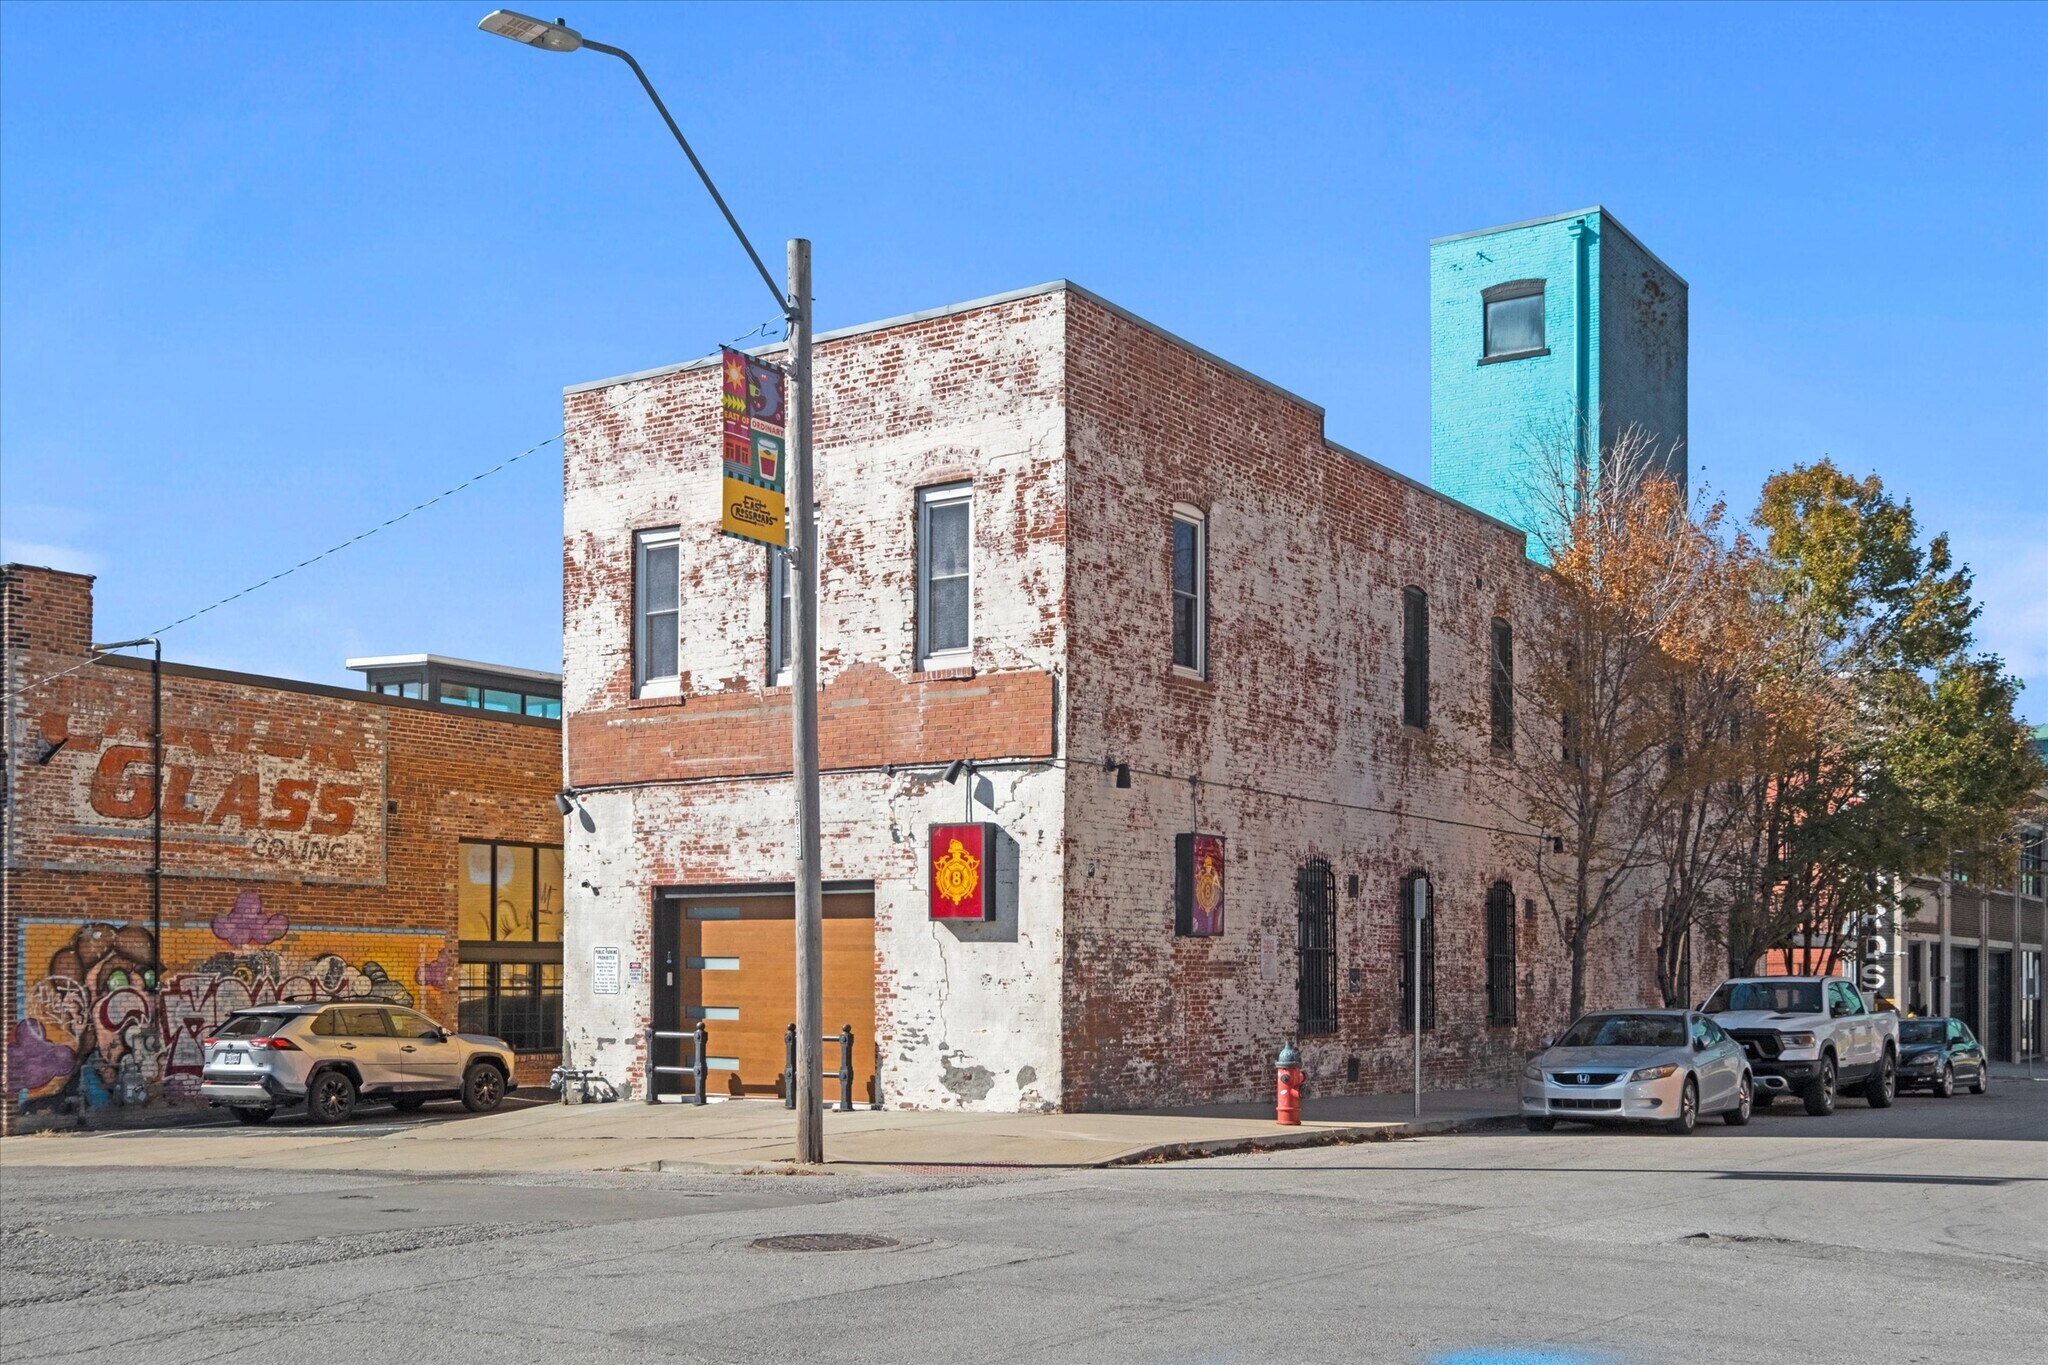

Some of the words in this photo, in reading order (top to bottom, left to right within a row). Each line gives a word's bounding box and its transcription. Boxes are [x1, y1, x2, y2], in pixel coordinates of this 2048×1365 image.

[724, 410, 740, 421] EAST
[741, 415, 750, 426] OF
[751, 420, 784, 437] ORDINARY
[90, 744, 363, 838] GLASS
